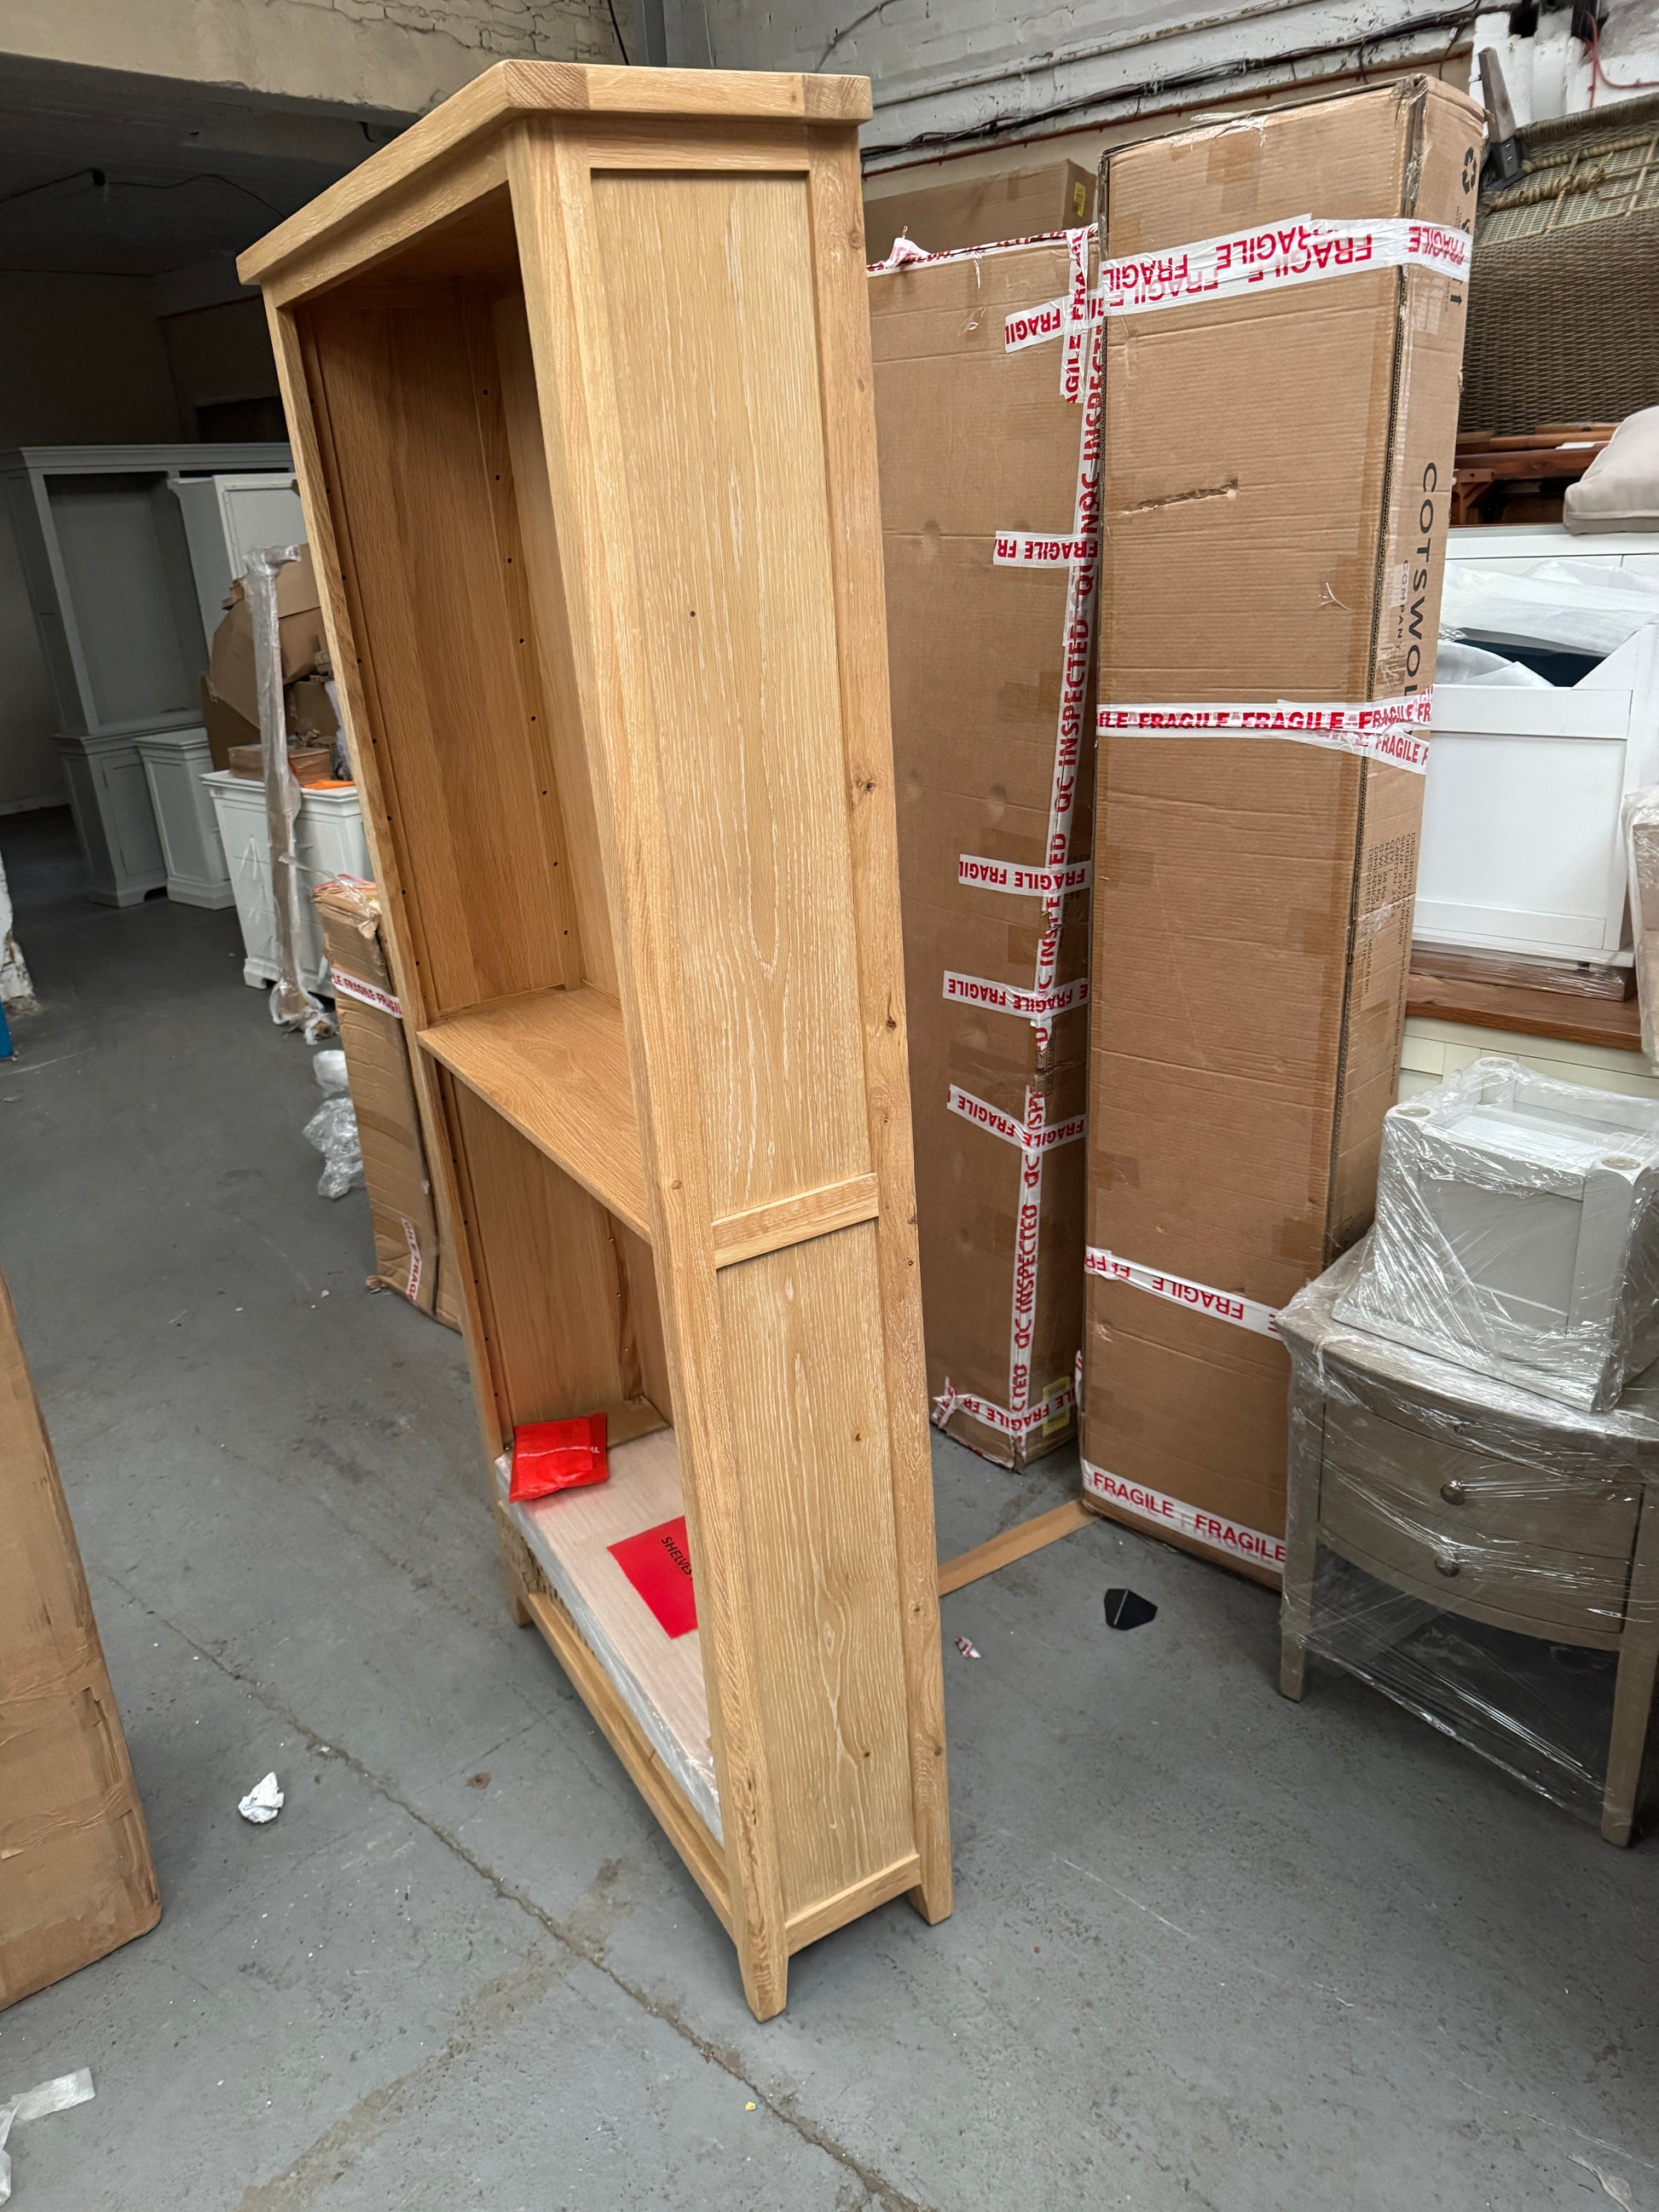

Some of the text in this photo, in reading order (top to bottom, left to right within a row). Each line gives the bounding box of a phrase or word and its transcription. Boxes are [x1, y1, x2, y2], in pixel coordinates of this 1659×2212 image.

[1102, 225, 1314, 292] RAGILE FRAGIL
[1024, 540, 1099, 561] FRAGILE
[1404, 462, 1437, 699] COTSWOL
[1058, 618, 1090, 767] INSPECTED
[1138, 712, 1230, 730] FRAGILE
[1241, 711, 1345, 731] FRAGILE
[1374, 734, 1421, 764] FRAGILE
[1055, 775, 1075, 812] QC
[959, 860, 1085, 891] FRAGILE FRAGIL
[948, 978, 1007, 1007] FRAGILE
[1014, 987, 1073, 1014] FRAGILE
[957, 1094, 1015, 1138] FRAGILE
[1021, 1119, 1085, 1147] FRAGILE
[1025, 1154, 1040, 1188] QC
[1015, 1203, 1038, 1314] INSPECTED
[1151, 1277, 1245, 1320] FRAGILE
[1014, 1318, 1032, 1349] QC
[986, 1403, 1050, 1432] FRAGILE
[1093, 1471, 1286, 1563] FRAGILE FRAGILE
[661, 1536, 692, 1575] SHELVES
